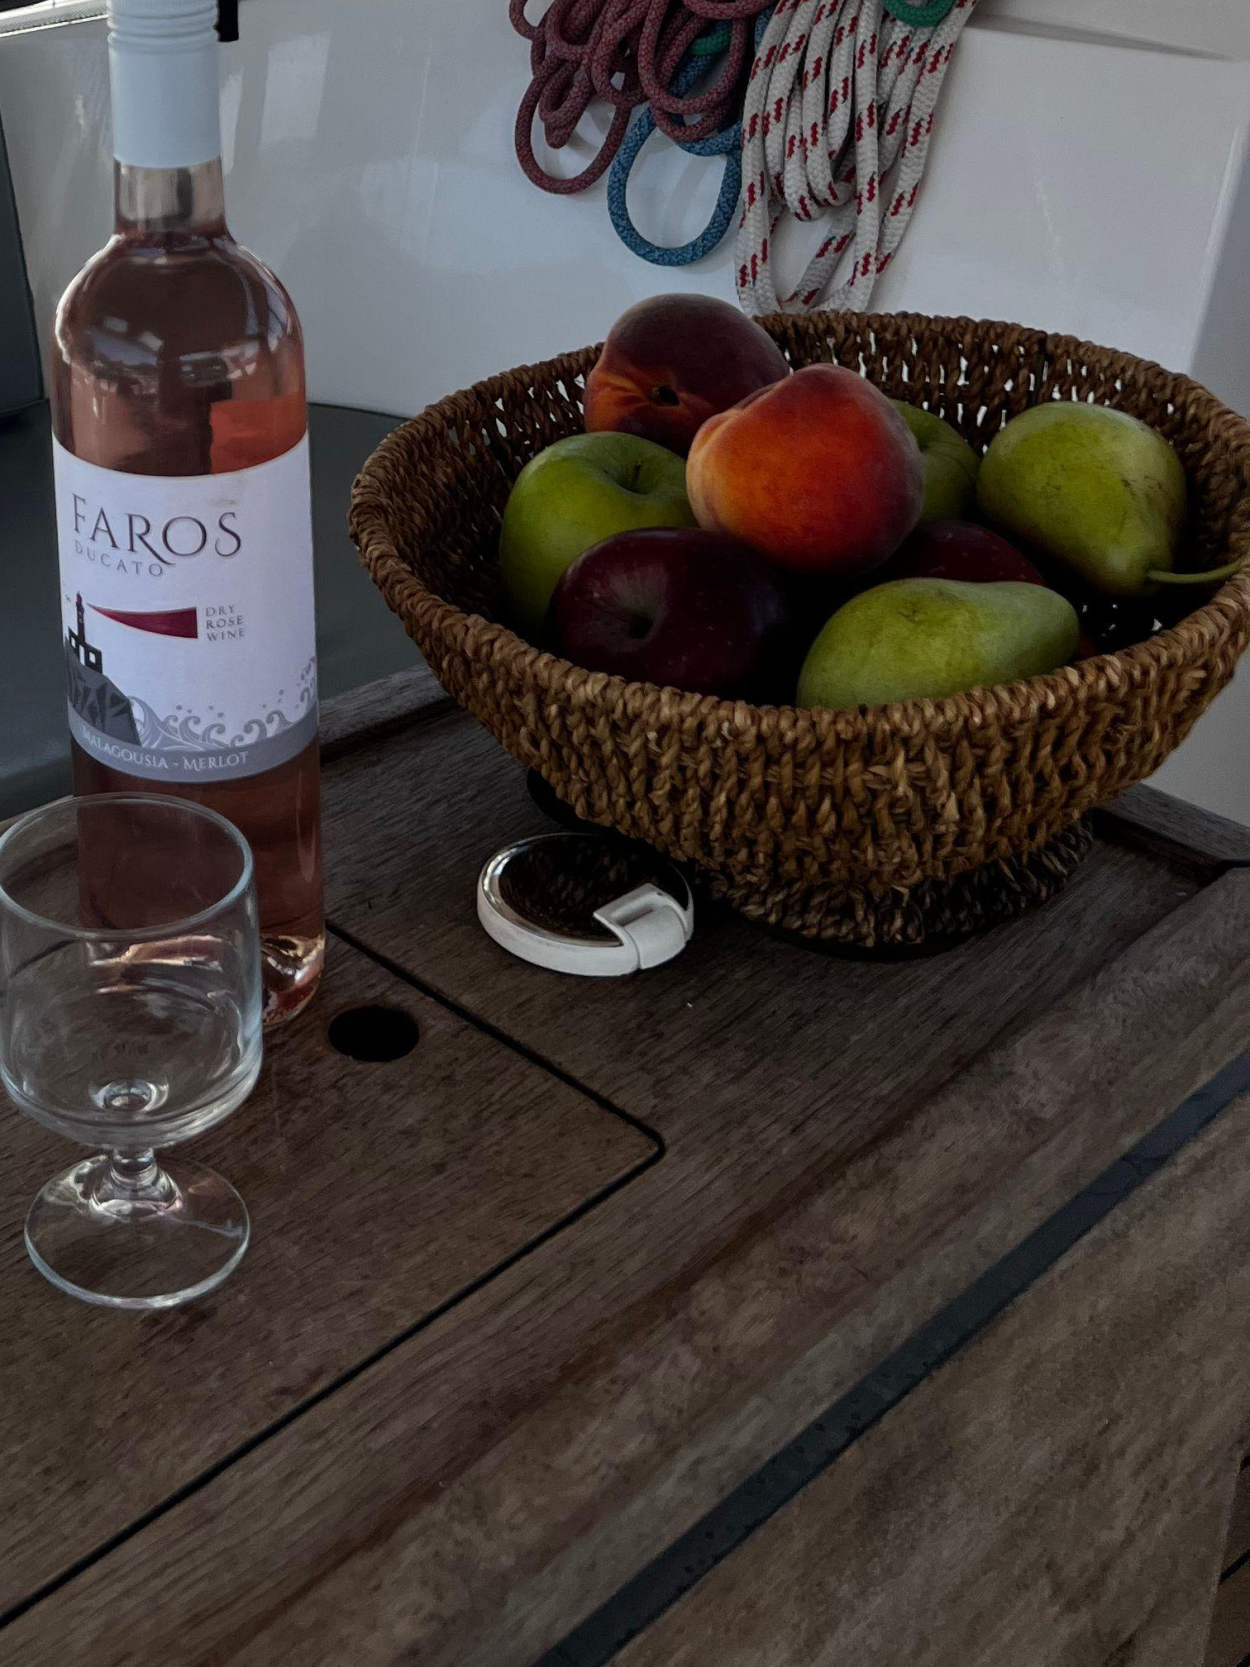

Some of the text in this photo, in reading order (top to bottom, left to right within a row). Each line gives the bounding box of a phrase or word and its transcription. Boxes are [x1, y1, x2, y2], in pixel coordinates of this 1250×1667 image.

[72, 493, 242, 567] FAROS
[75, 539, 164, 577] DUCATO
[205, 604, 235, 617] DRY
[205, 614, 245, 630] ROSE
[206, 627, 246, 642] WINE
[182, 750, 249, 772] MERLOT
